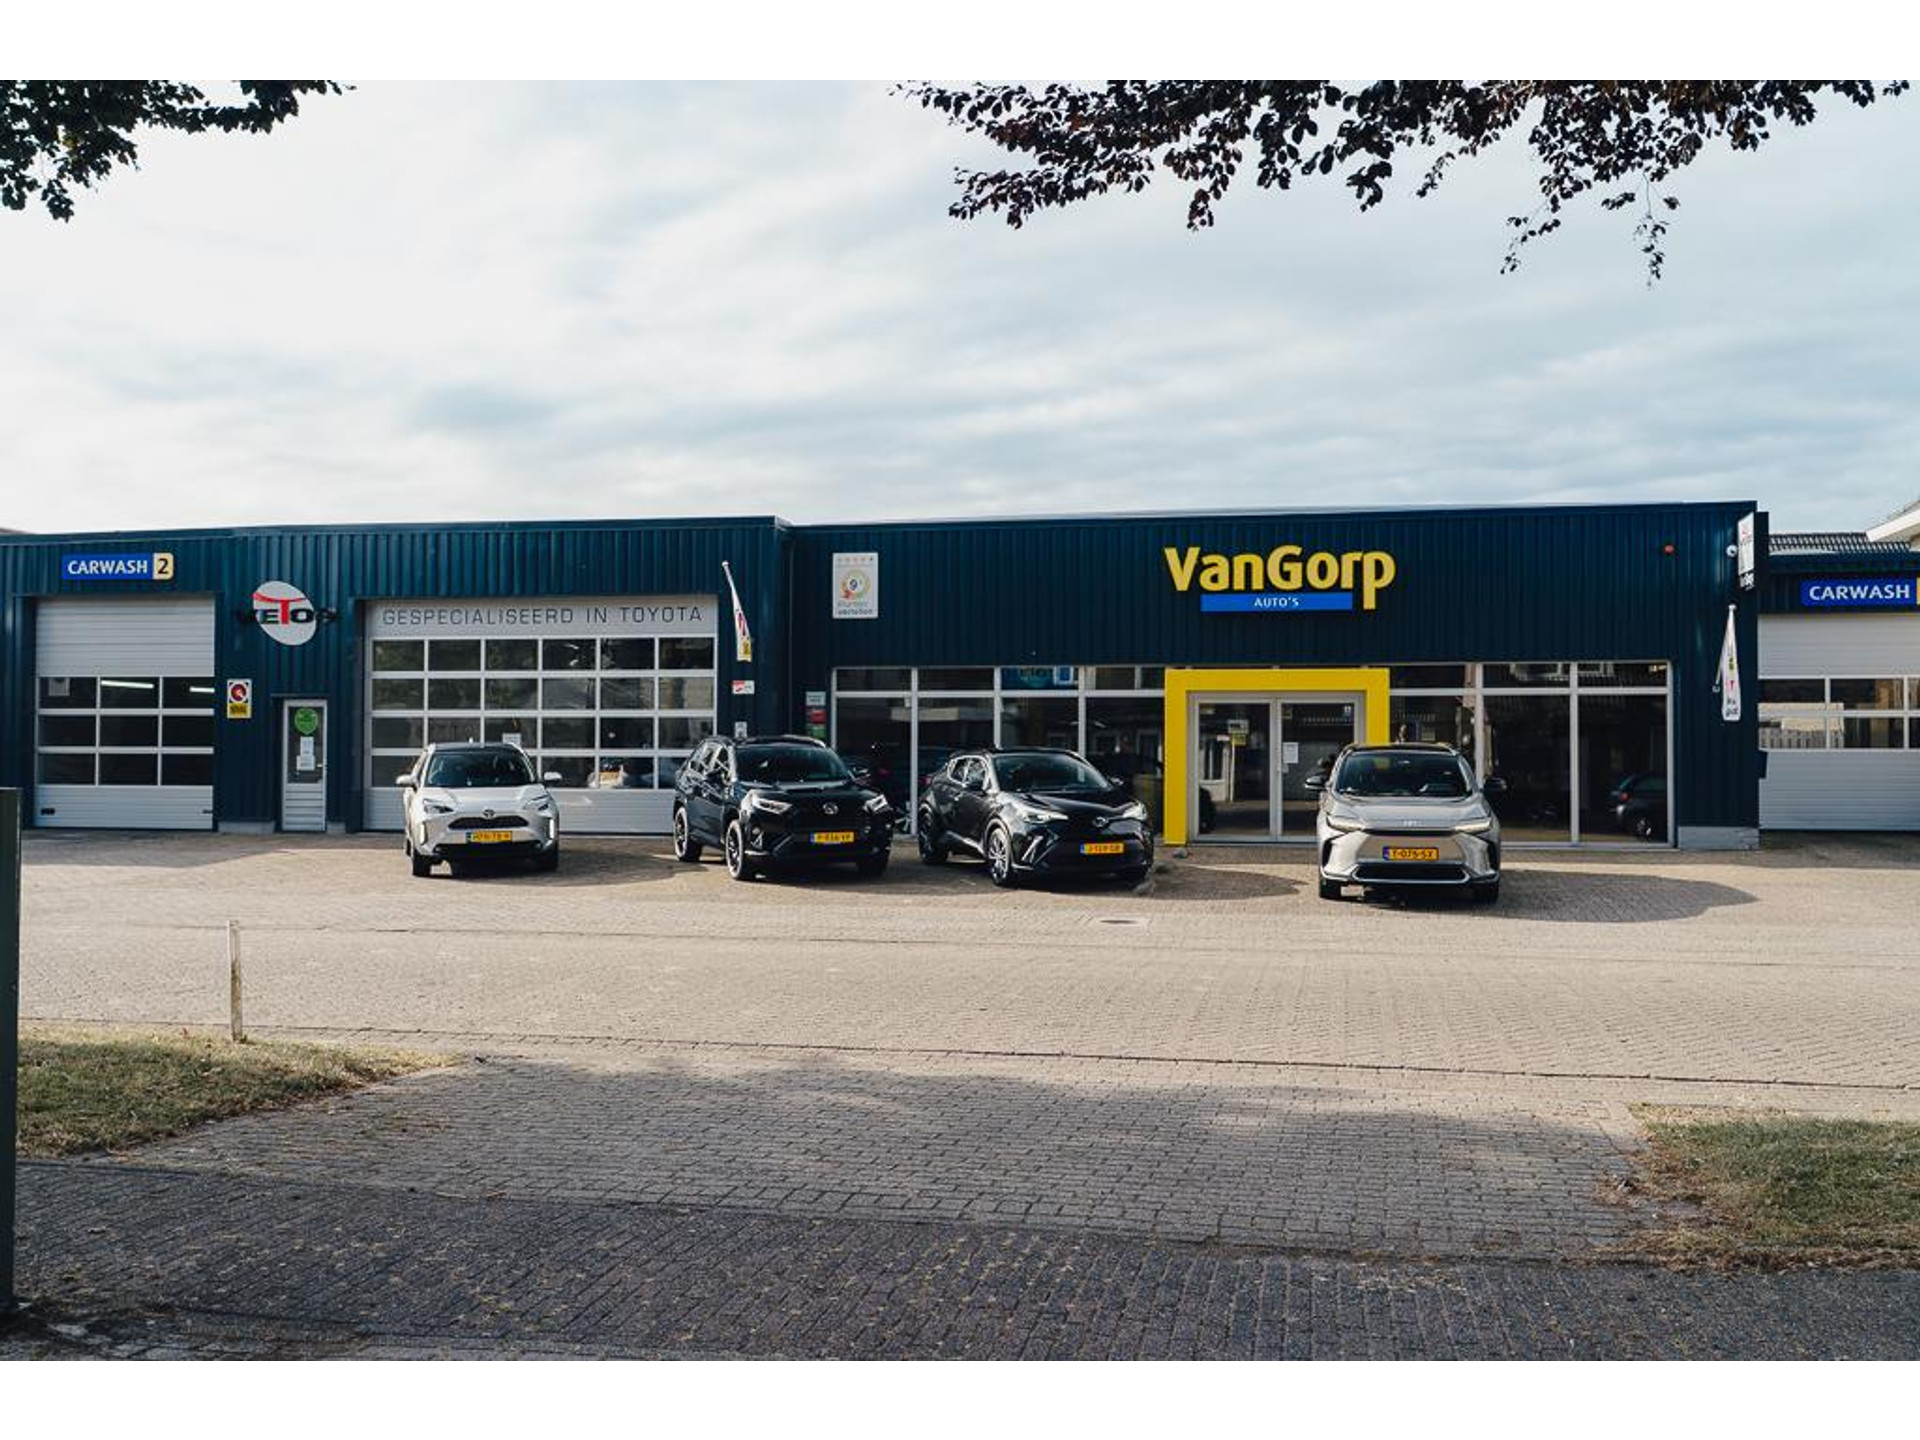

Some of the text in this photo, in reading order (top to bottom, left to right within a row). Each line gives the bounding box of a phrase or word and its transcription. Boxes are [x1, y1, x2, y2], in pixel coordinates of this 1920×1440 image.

[67, 557, 170, 575] CARWASH 2
[1164, 544, 1396, 610] VanGorp
[1808, 584, 1911, 601] CARWASH
[1253, 597, 1300, 608] AUTO'S
[382, 605, 703, 626] GESPECIALISEERD IN TOYOTA
